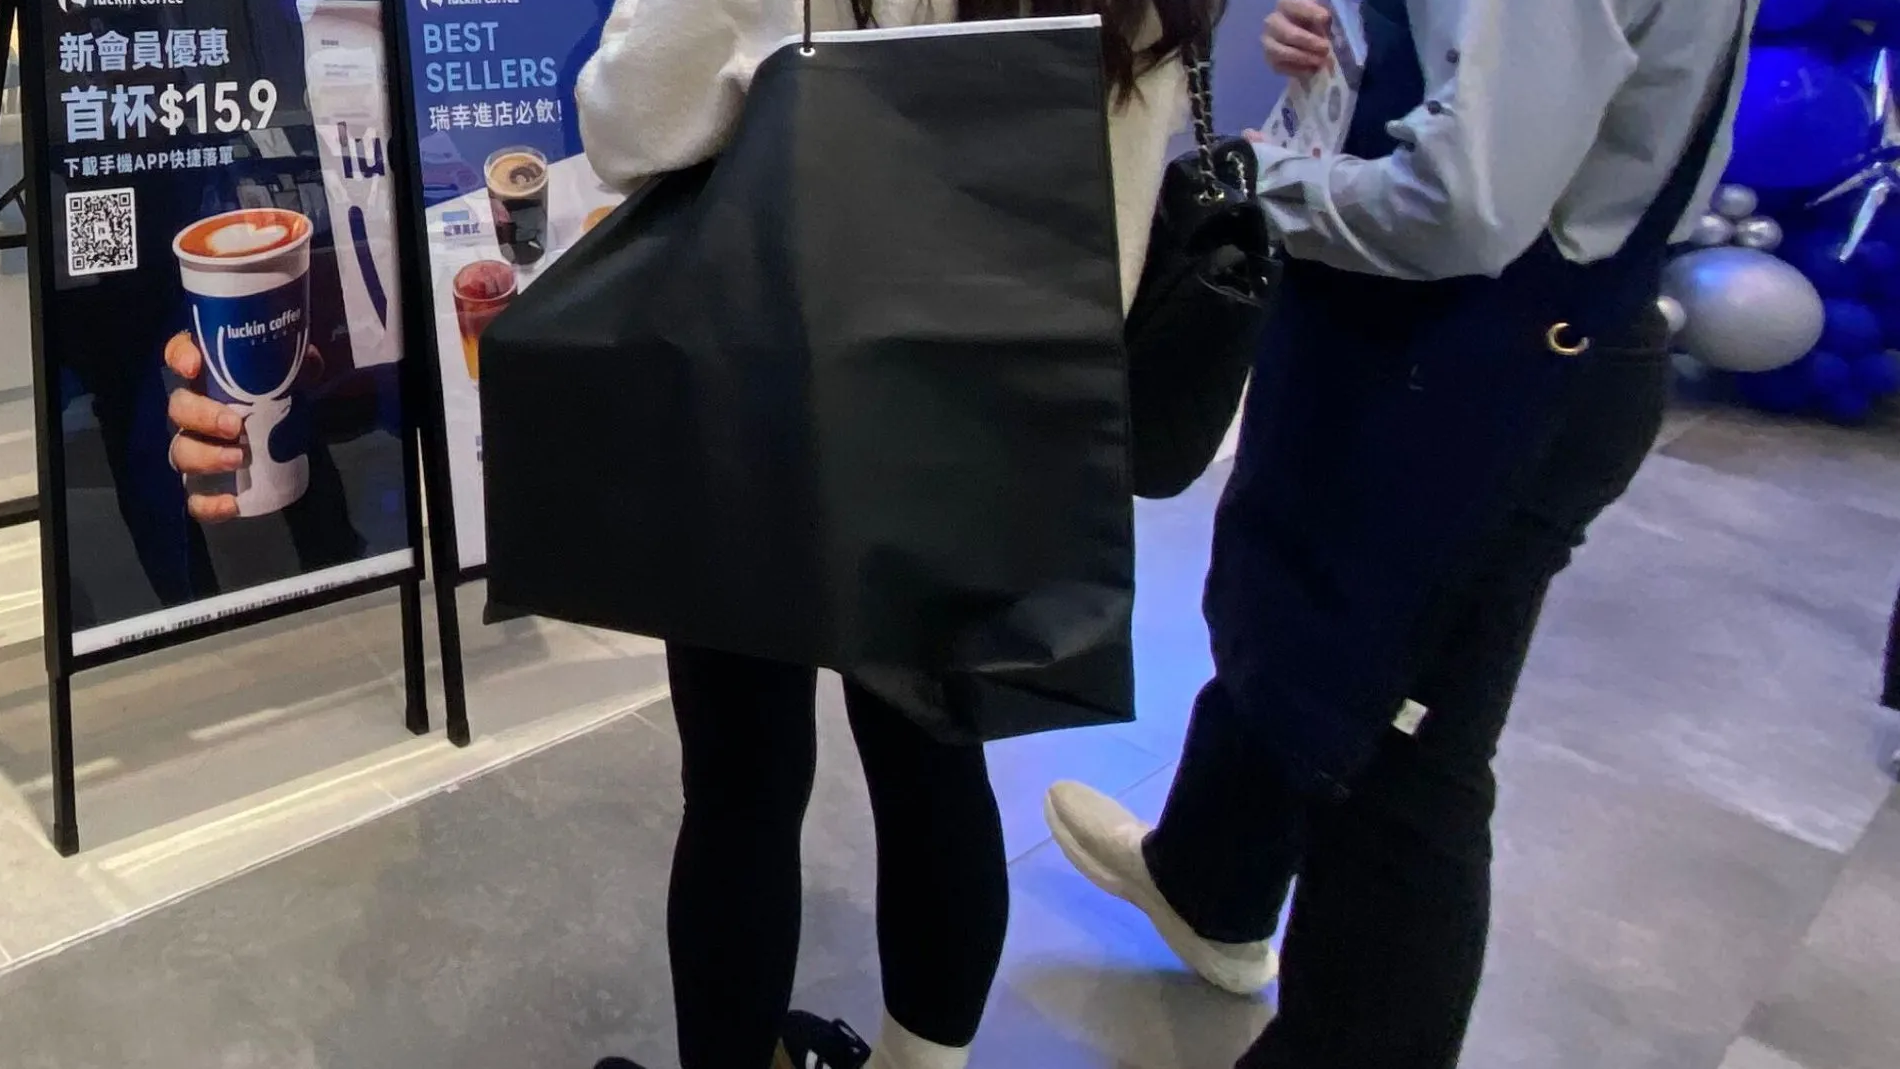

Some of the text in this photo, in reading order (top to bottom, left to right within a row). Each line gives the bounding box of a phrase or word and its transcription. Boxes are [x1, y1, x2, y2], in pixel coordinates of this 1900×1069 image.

[59, 28, 230, 73] 新會員優惠
[423, 22, 499, 54] BEST
[426, 57, 558, 93] SELLERS
[61, 79, 278, 143] 首杯$15.9
[429, 98, 563, 132] 瑞幸進店必飲!
[64, 145, 235, 178] 下載手機APP快捷落單
[227, 320, 265, 339] luckin
